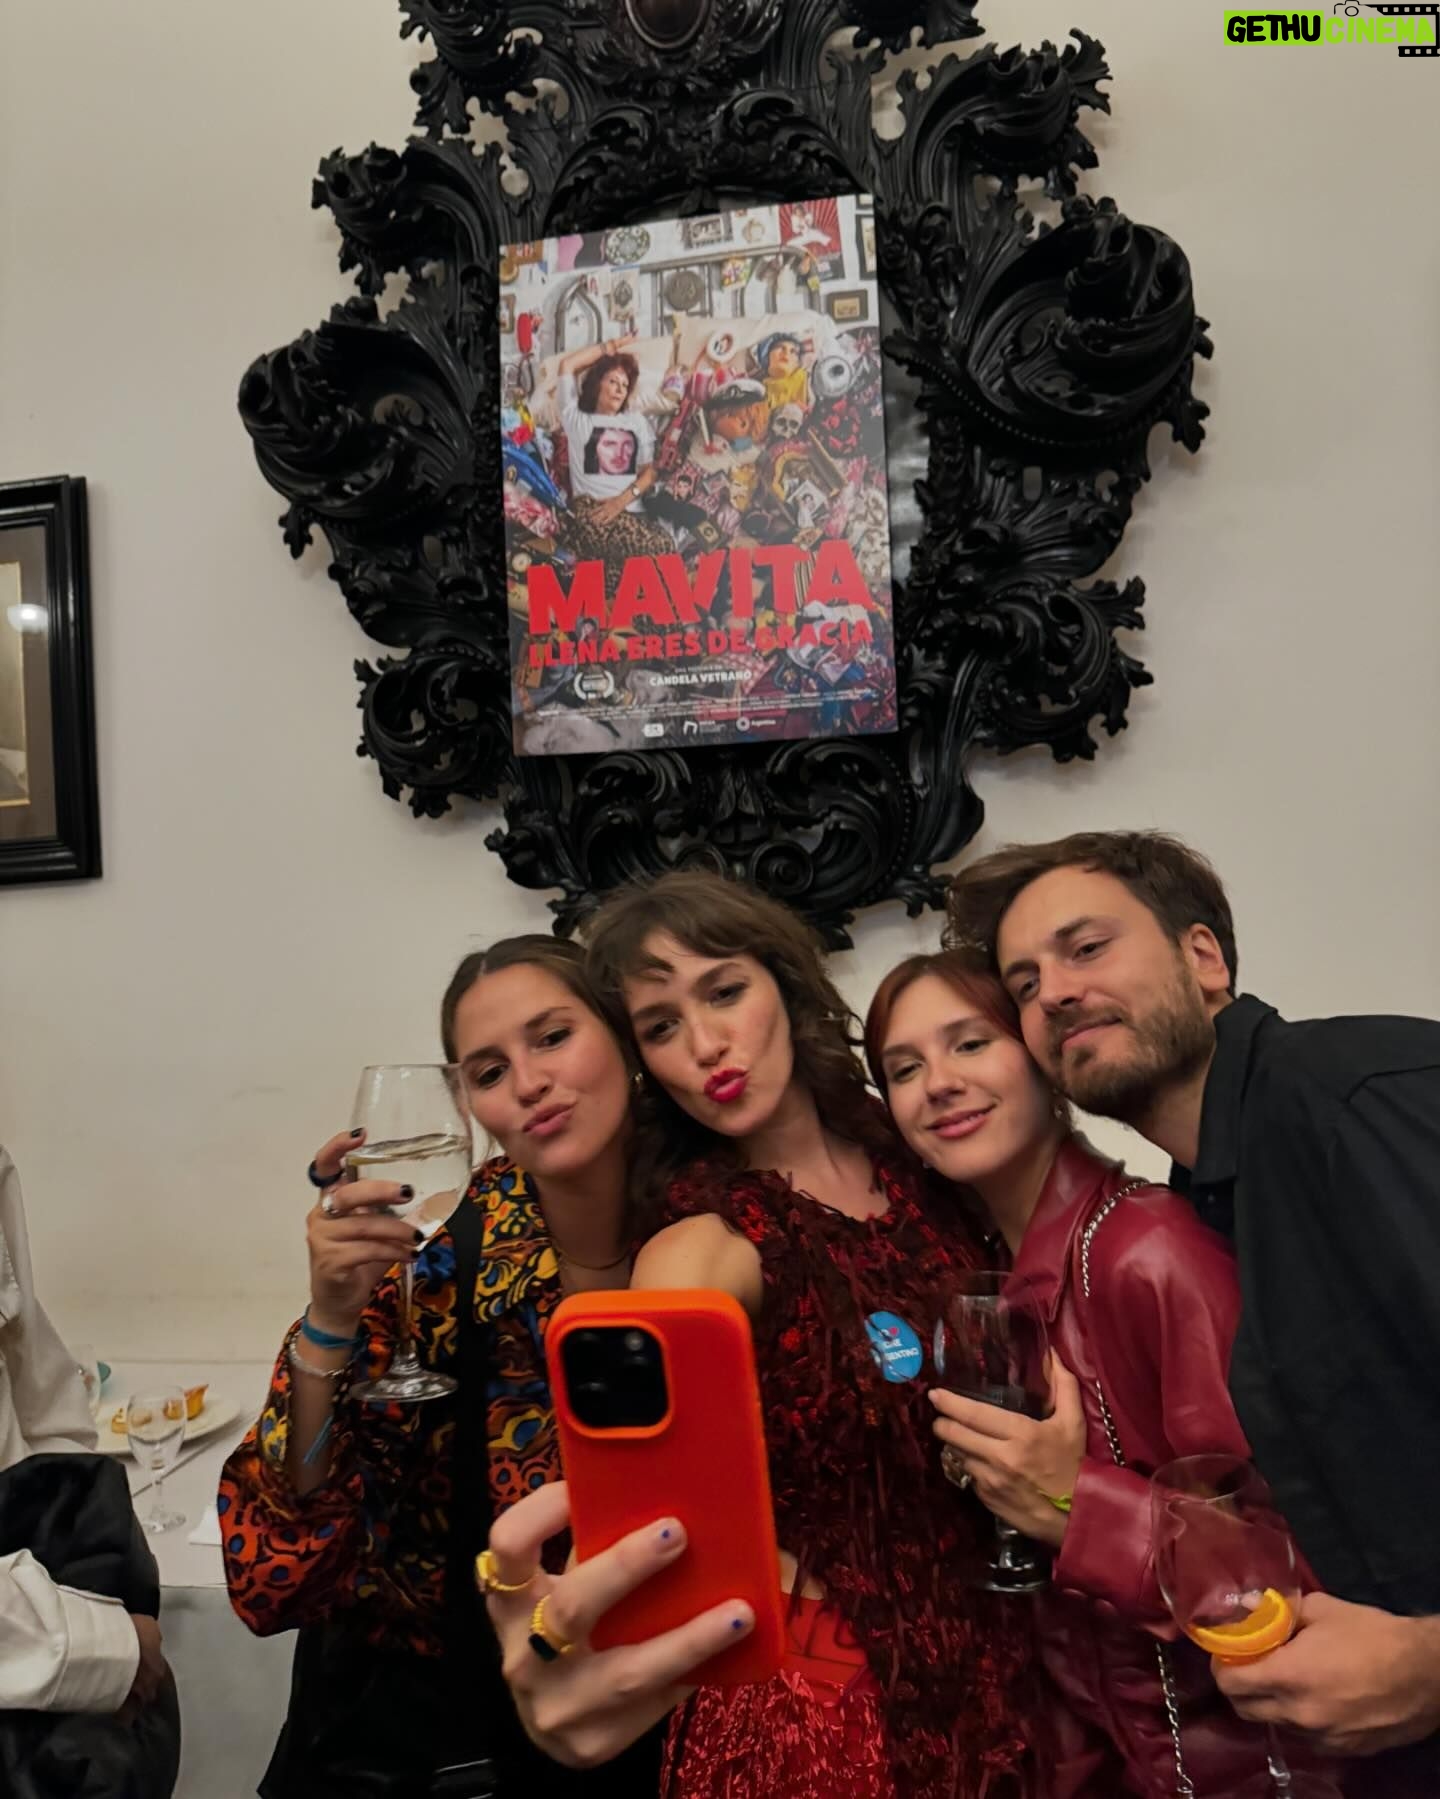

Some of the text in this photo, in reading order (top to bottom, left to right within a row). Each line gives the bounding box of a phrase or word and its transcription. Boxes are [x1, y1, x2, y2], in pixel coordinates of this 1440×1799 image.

[527, 539, 878, 635] MAVITA
[529, 619, 873, 668] LLENA ERES DE GRACIA
[649, 669, 752, 687] CANDELA VETRANO
